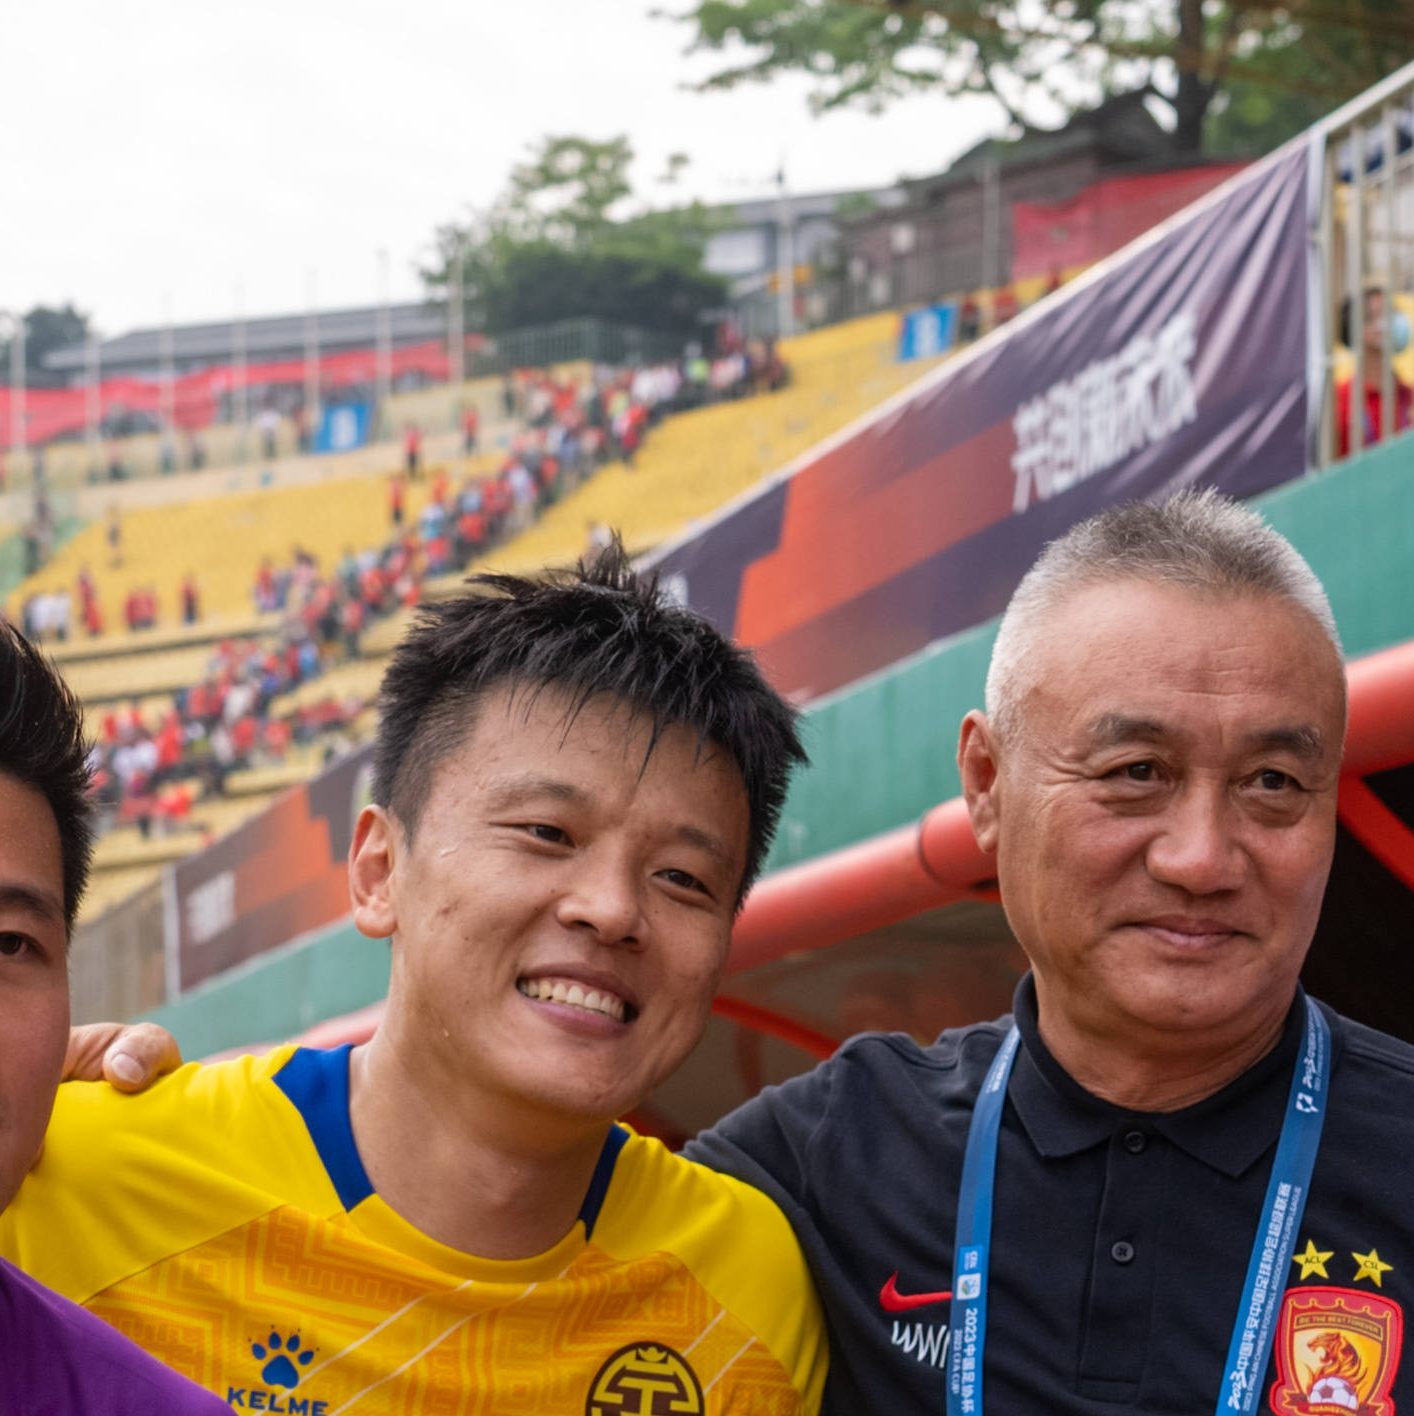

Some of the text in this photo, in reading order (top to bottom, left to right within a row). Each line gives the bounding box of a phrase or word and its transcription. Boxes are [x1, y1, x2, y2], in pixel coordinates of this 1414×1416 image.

[1262, 1291, 1277, 1330] FOOTBALL
[1271, 1241, 1289, 1291] ASSOCIATION
[1283, 1215, 1295, 1241] SUPER
[1289, 1186, 1302, 1216] LEAGUE
[951, 1376, 961, 1395] CUP
[952, 1353, 962, 1374] CFA
[961, 1307, 978, 1413] 2023中国足协杯
